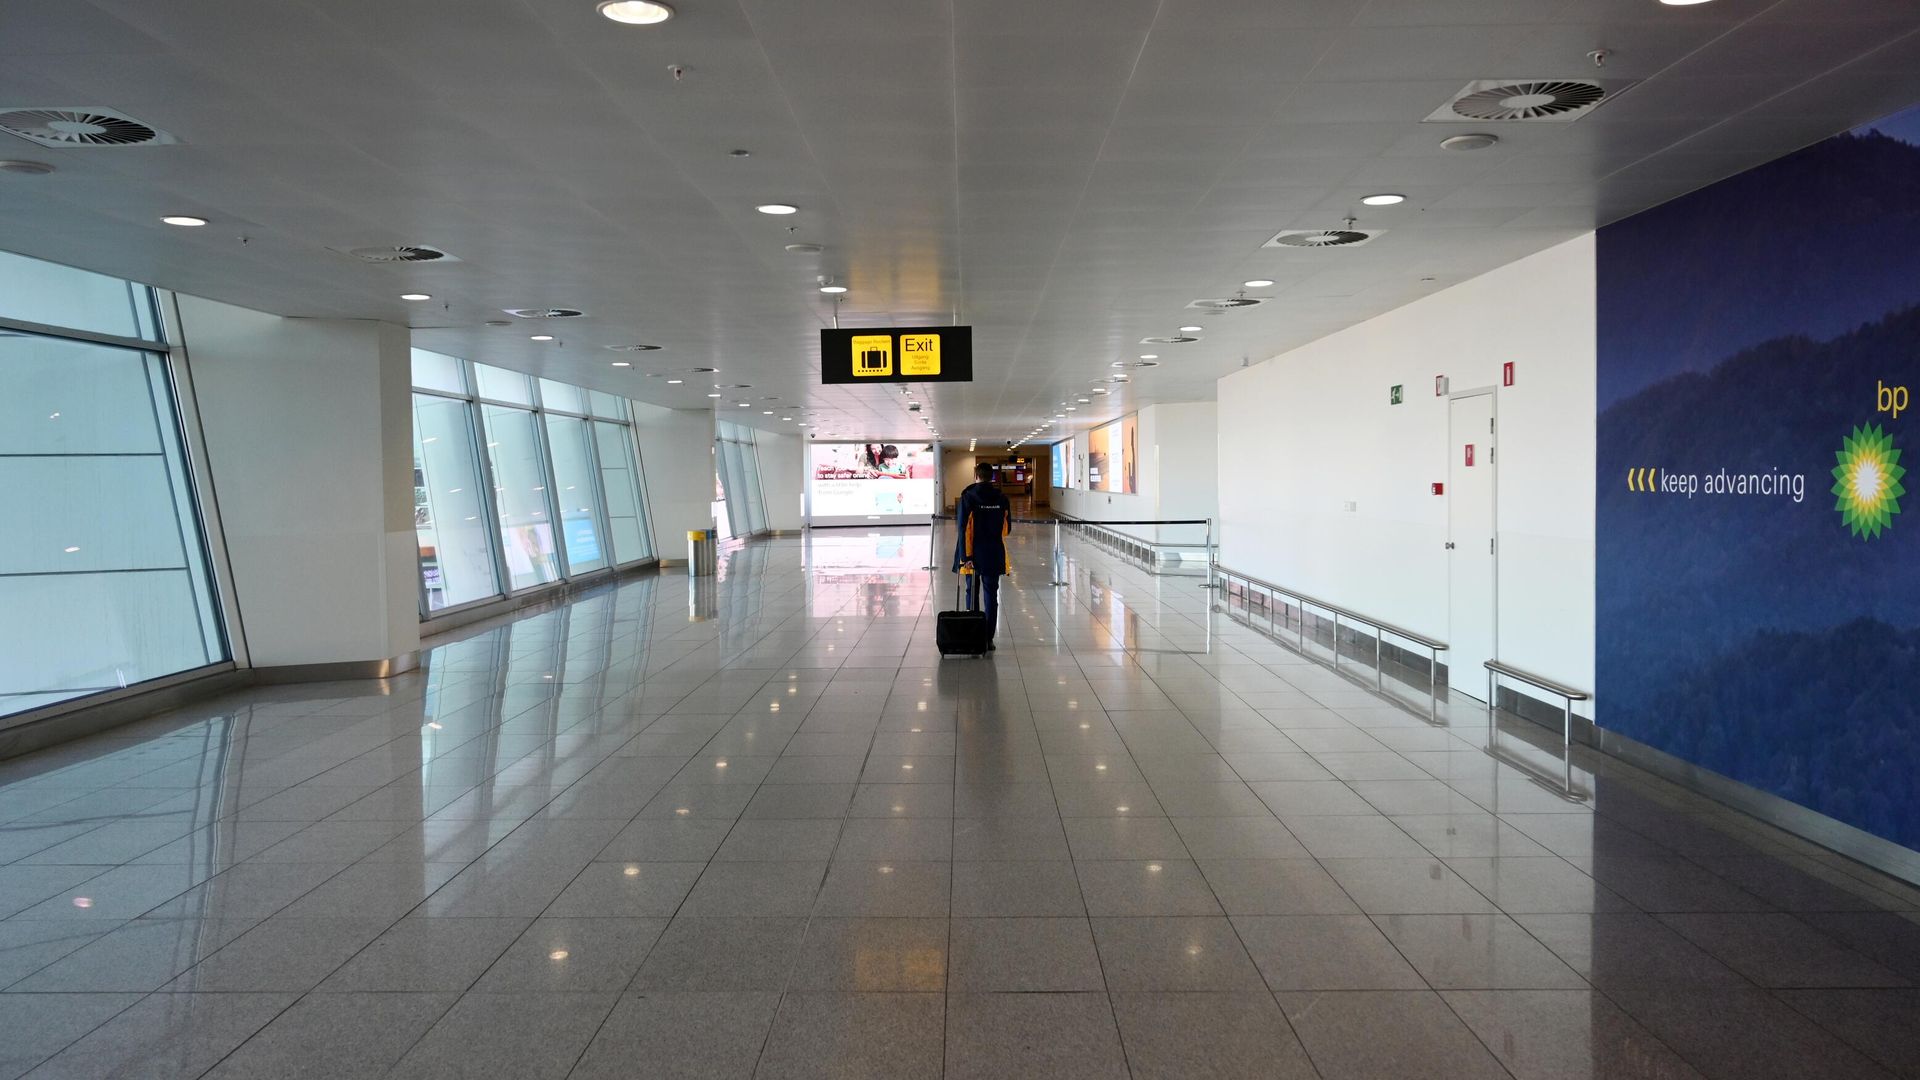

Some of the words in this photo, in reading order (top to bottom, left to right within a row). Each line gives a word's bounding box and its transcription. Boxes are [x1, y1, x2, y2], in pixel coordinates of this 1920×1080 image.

[905, 338, 933, 351] Exit
[1877, 380, 1909, 419] bp
[1661, 467, 1698, 499] keep
[1704, 467, 1805, 503] advancing
